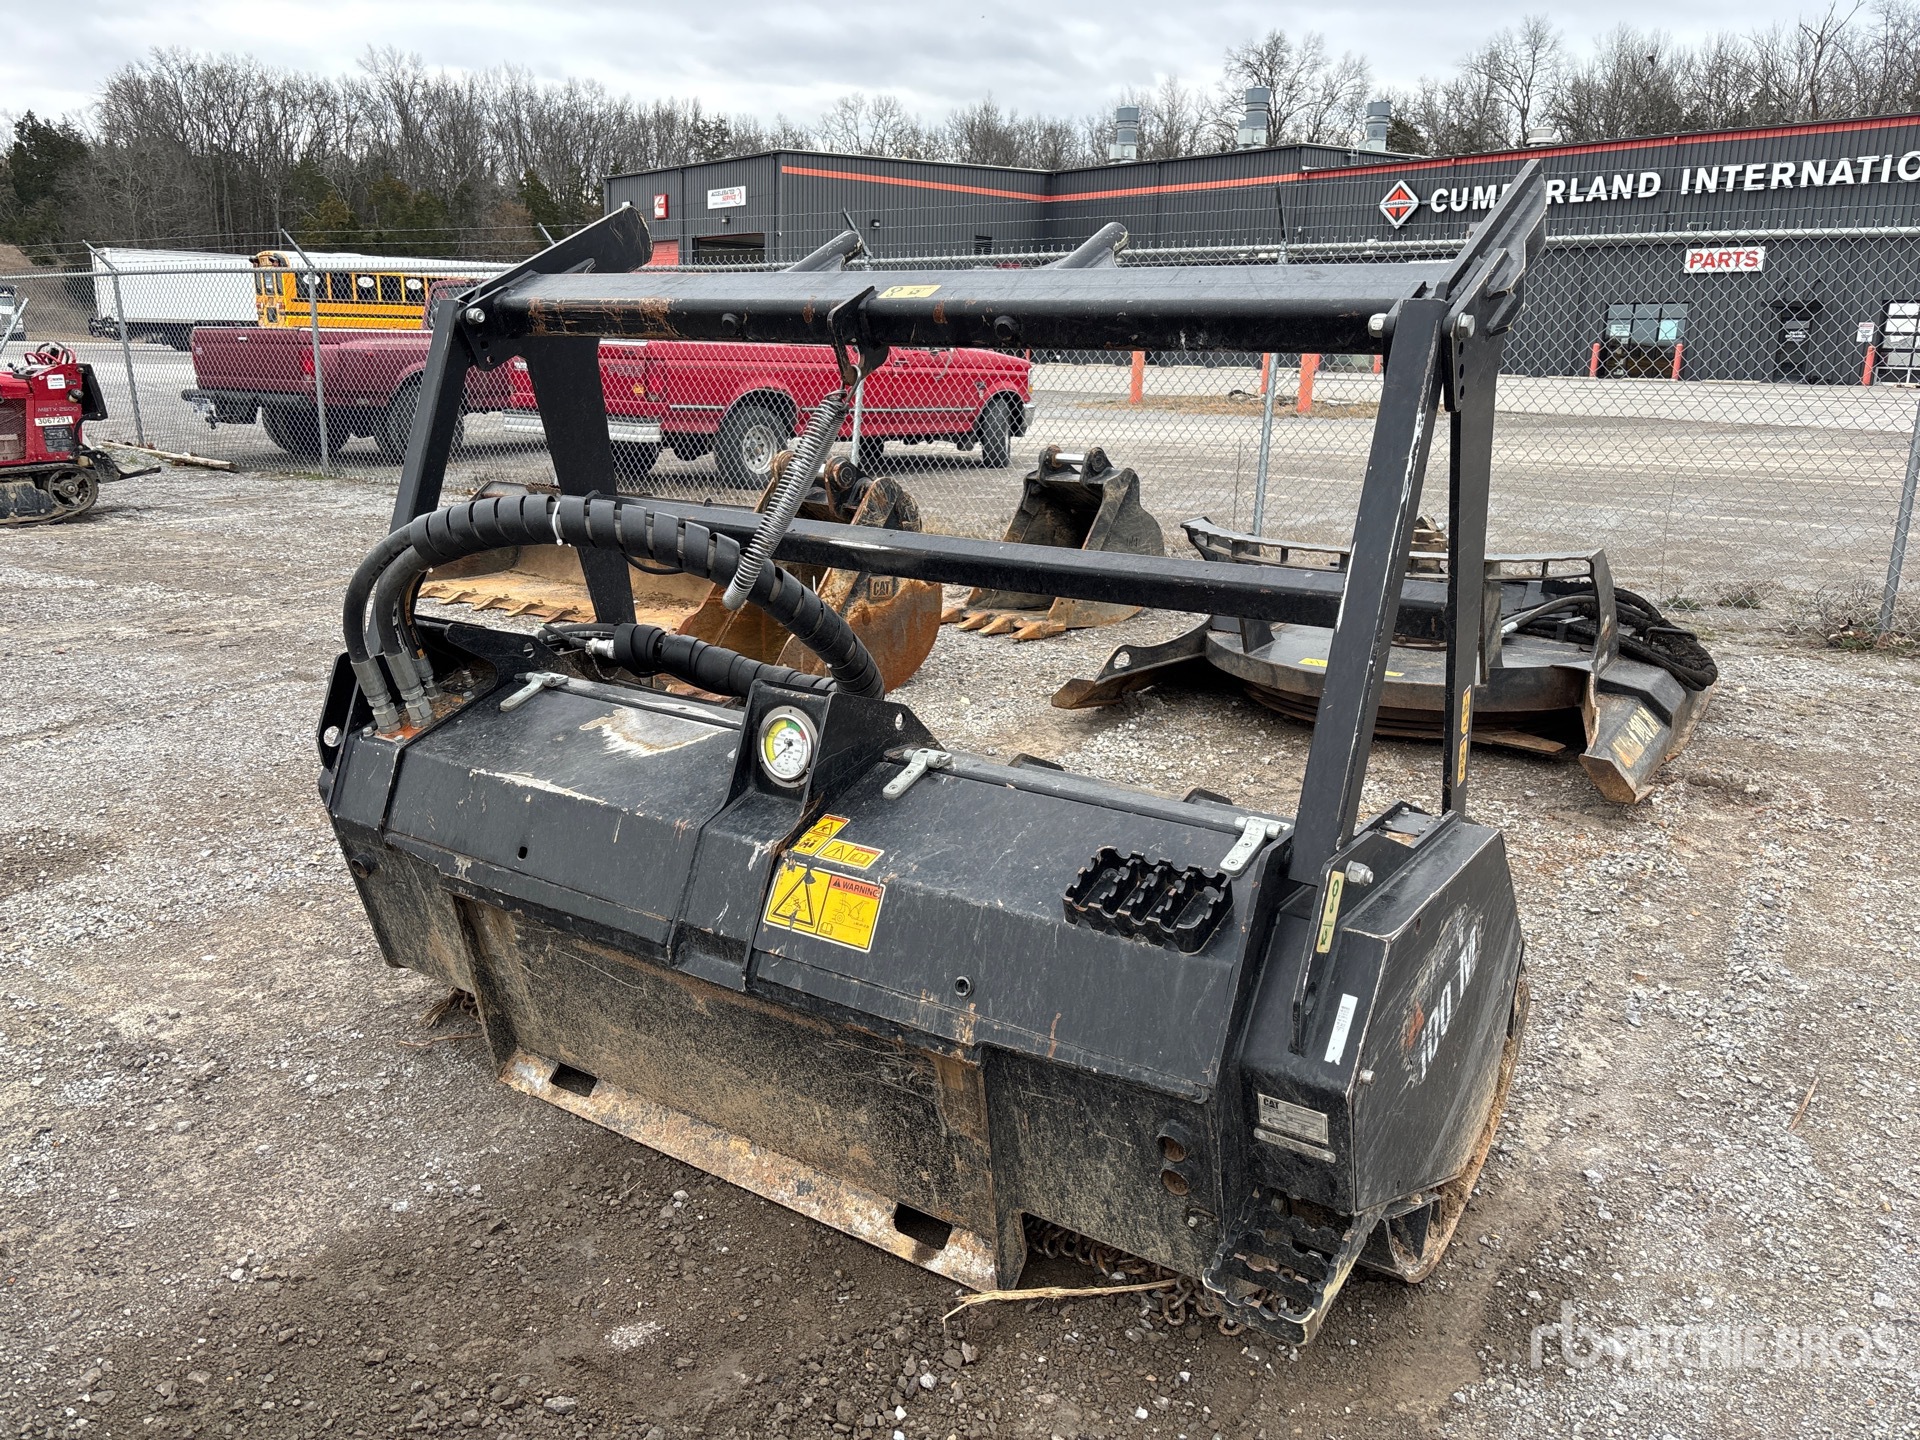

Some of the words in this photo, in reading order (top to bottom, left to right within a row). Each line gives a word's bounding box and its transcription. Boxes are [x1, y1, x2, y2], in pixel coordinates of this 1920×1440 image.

[1430, 171, 1662, 213] CUMRLAND
[1689, 250, 1760, 269] PARTS
[38, 416, 70, 425] 3067291
[873, 580, 890, 596] CAT
[842, 881, 881, 898] WARNING
[1263, 1098, 1280, 1110] CAT
